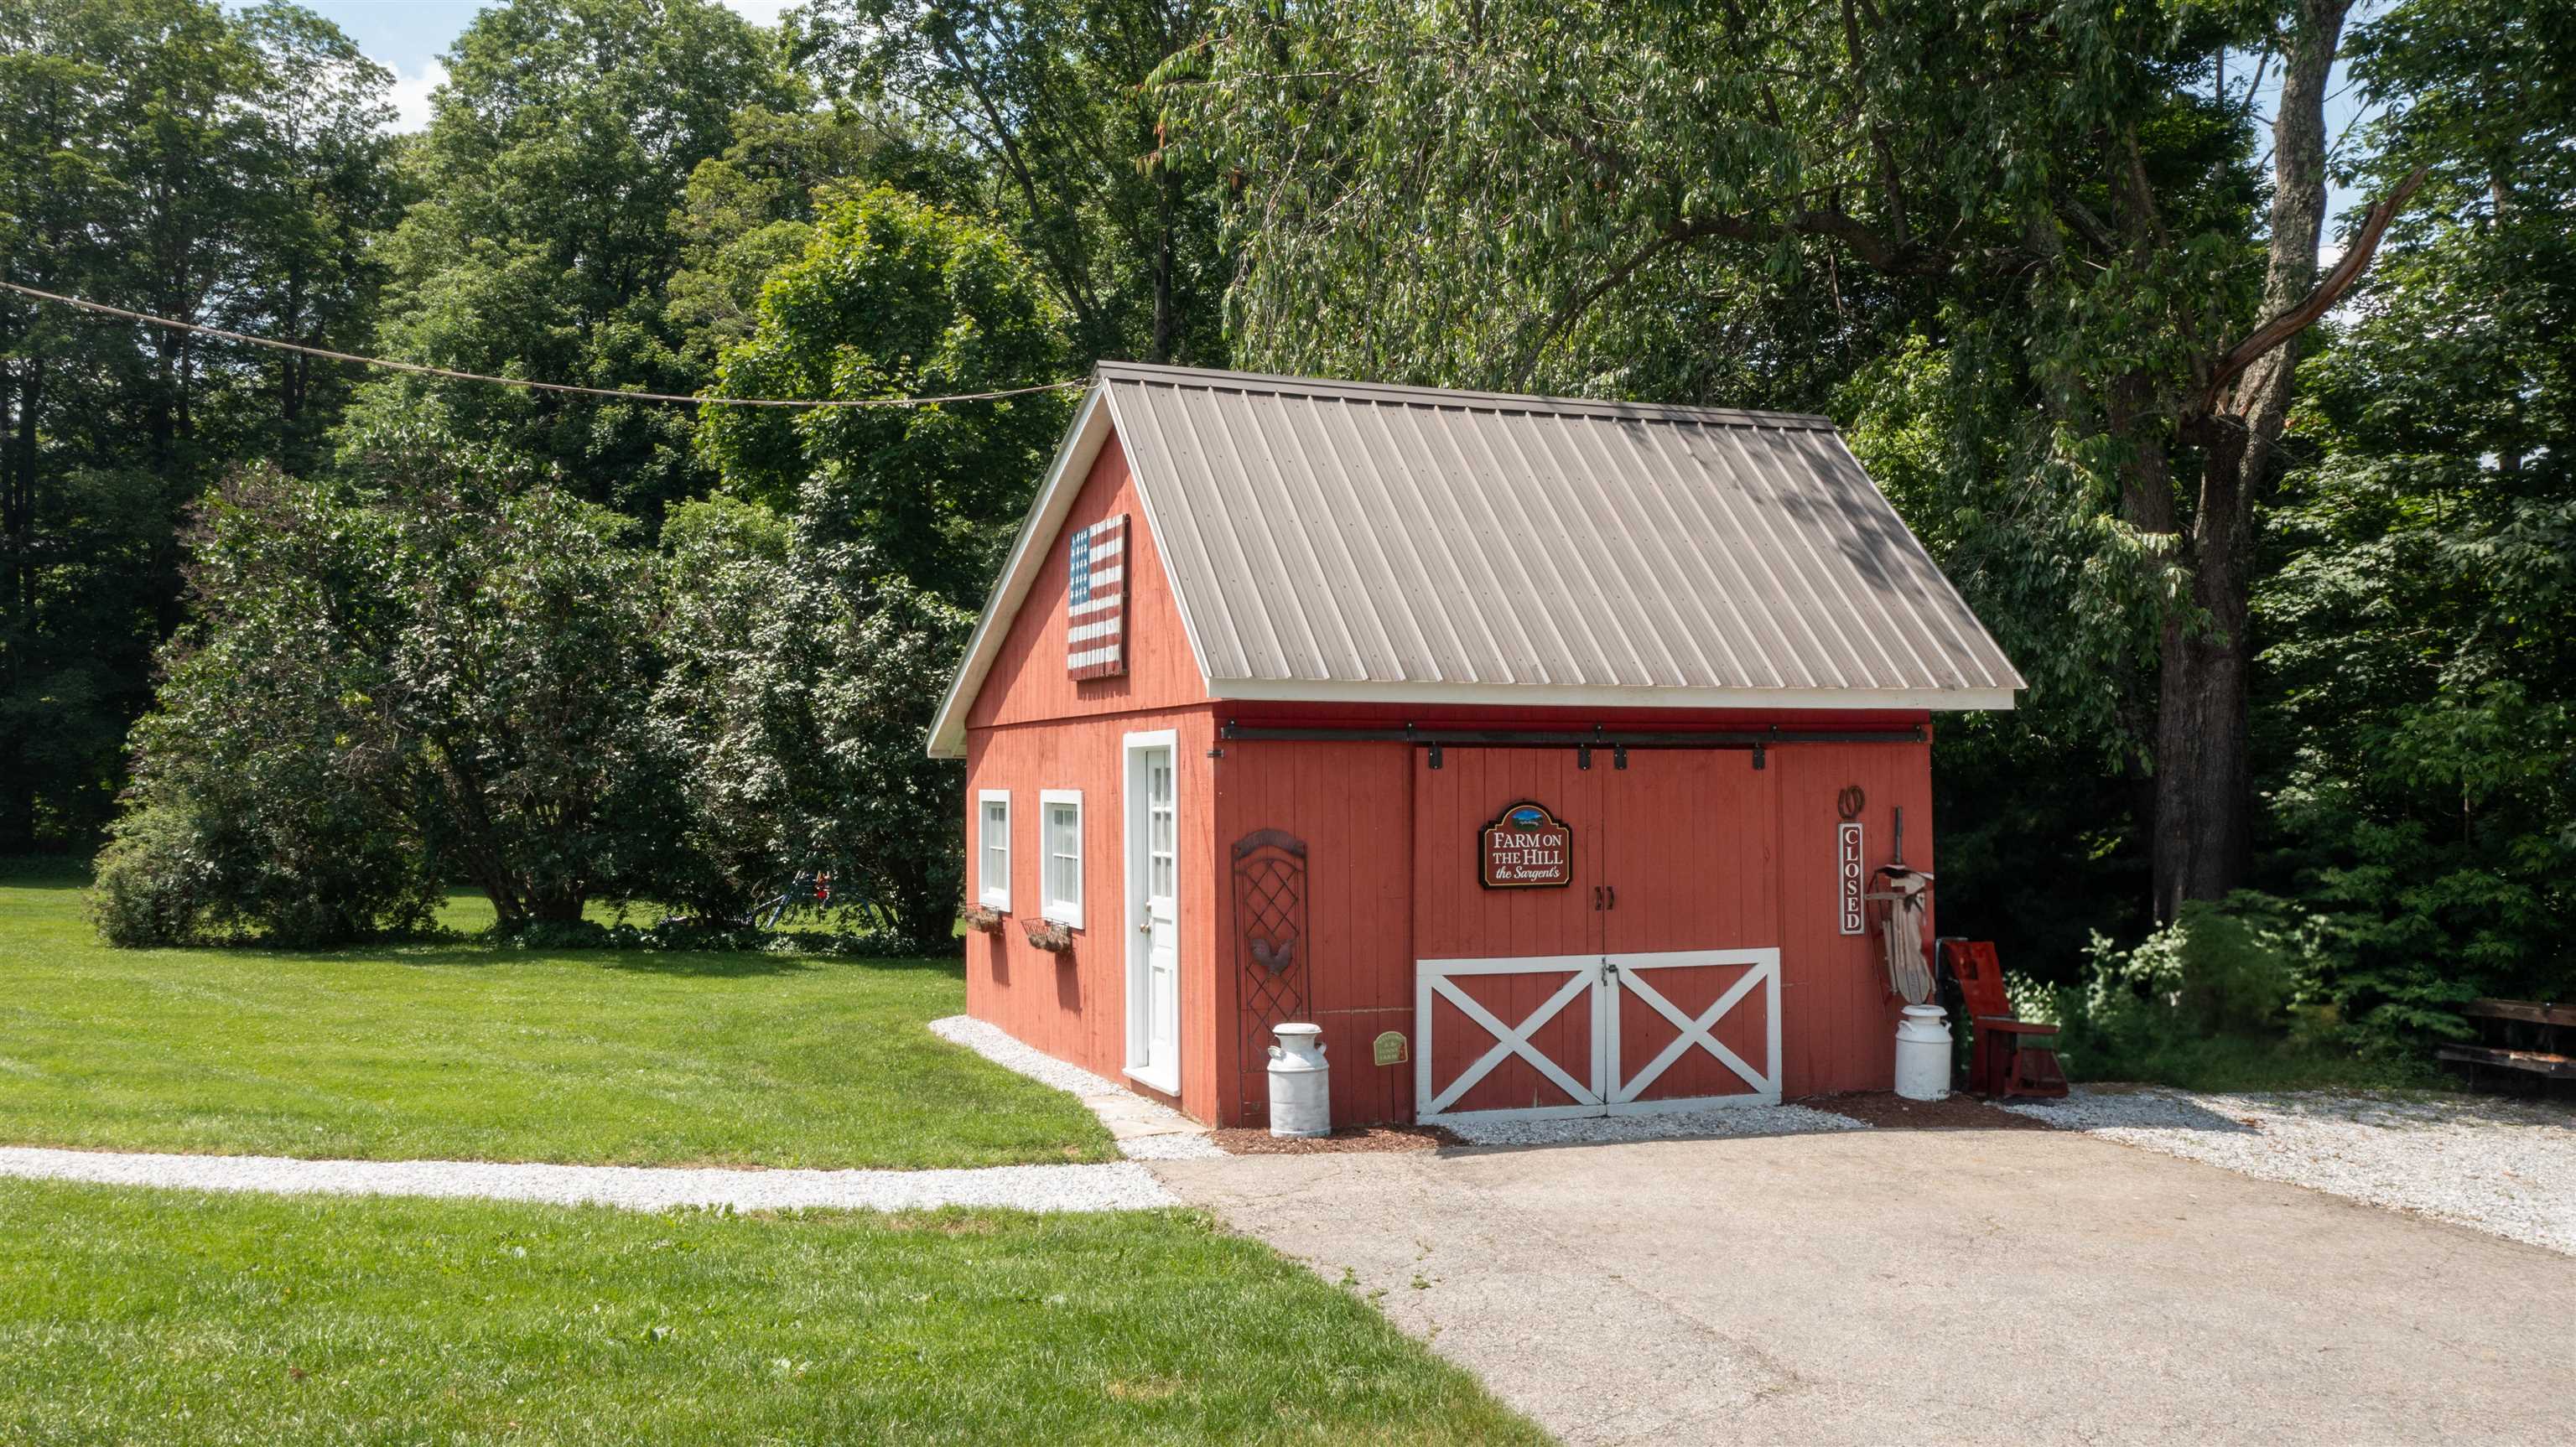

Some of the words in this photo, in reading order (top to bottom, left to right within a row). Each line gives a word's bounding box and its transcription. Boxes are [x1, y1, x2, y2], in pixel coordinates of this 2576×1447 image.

[1493, 832, 1540, 848] FARM
[1543, 834, 1562, 847] ON
[1493, 852, 1521, 864] THE
[1523, 848, 1564, 865] HILL
[1496, 865, 1512, 879] the
[1514, 865, 1561, 882] Sargent's
[1845, 829, 1860, 929] CLOSED
